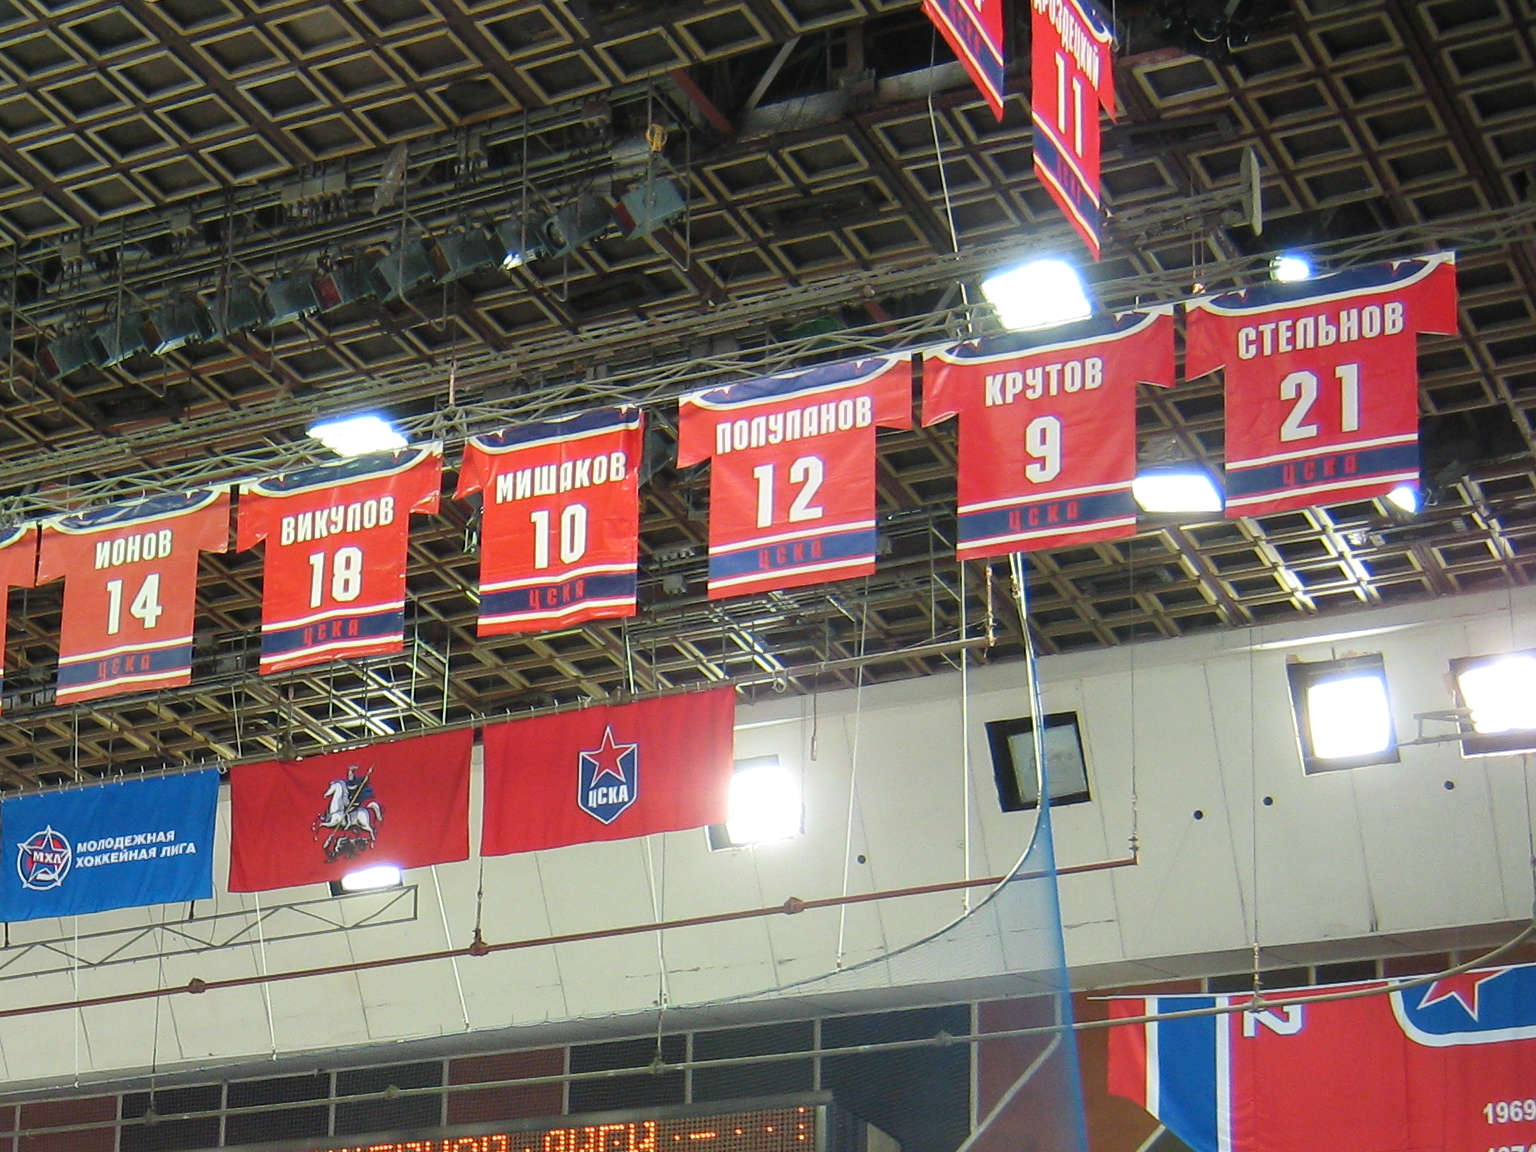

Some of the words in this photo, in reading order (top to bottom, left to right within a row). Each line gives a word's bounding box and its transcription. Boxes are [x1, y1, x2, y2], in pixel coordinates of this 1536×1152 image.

[1033, 0, 1099, 91] ОЗДЕЦКИЙ
[1056, 51, 1082, 159] 11
[1237, 301, 1405, 361] СТЕЛЬНОВ
[984, 356, 1103, 407] КРУТОВ
[1279, 362, 1360, 444] 21
[716, 395, 873, 456] ПОЛУПАНОВ
[1023, 415, 1061, 485] 9
[496, 451, 628, 505] МИШАКОВ
[753, 454, 825, 530] 12
[94, 529, 173, 570] ИОНОВ
[280, 496, 395, 547] ВИКУЛОВ
[530, 502, 588, 570] 10
[106, 573, 163, 635] 14
[309, 545, 363, 609] 18
[587, 784, 628, 808] ЦСКА
[32, 851, 63, 864] МХЛ
[75, 848, 158, 869] ХОККЕЙНАЯ
[159, 843, 197, 859] ЛИГА
[76, 829, 176, 854] МОЛОДЕЖНАЯ
[1483, 1099, 1536, 1125] 1969
